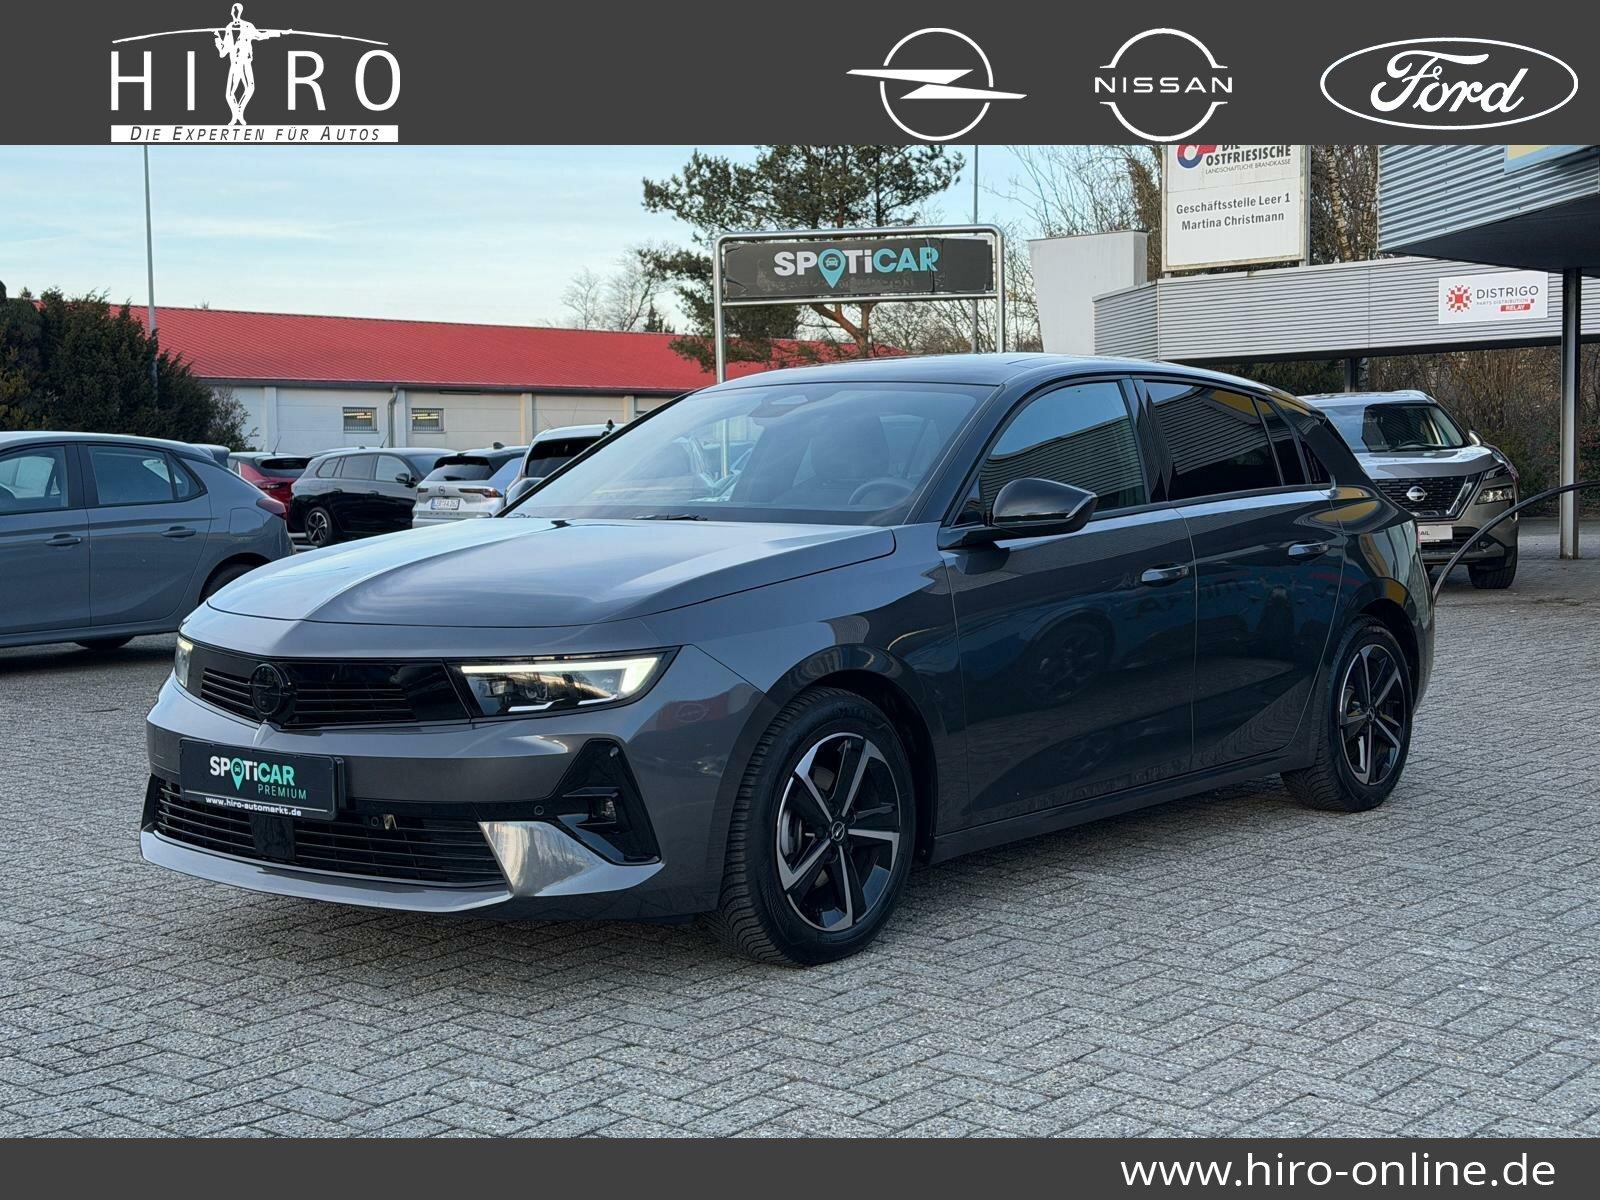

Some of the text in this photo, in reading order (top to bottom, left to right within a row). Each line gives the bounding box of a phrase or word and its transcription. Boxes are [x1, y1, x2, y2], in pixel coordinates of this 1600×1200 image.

[1206, 145, 1291, 167] OSTFRIESISCHE
[1205, 158, 1291, 175] LANDSCHAFTLICHE BRANDKASSE
[1176, 192, 1290, 215] Geschäftsstelle Leer 1
[1181, 212, 1285, 231] Martina Christmann
[1476, 285, 1539, 299] DISTRIGO
[258, 784, 307, 800] PREMIUM
[205, 797, 302, 817] www.hiro-automarkt.de
